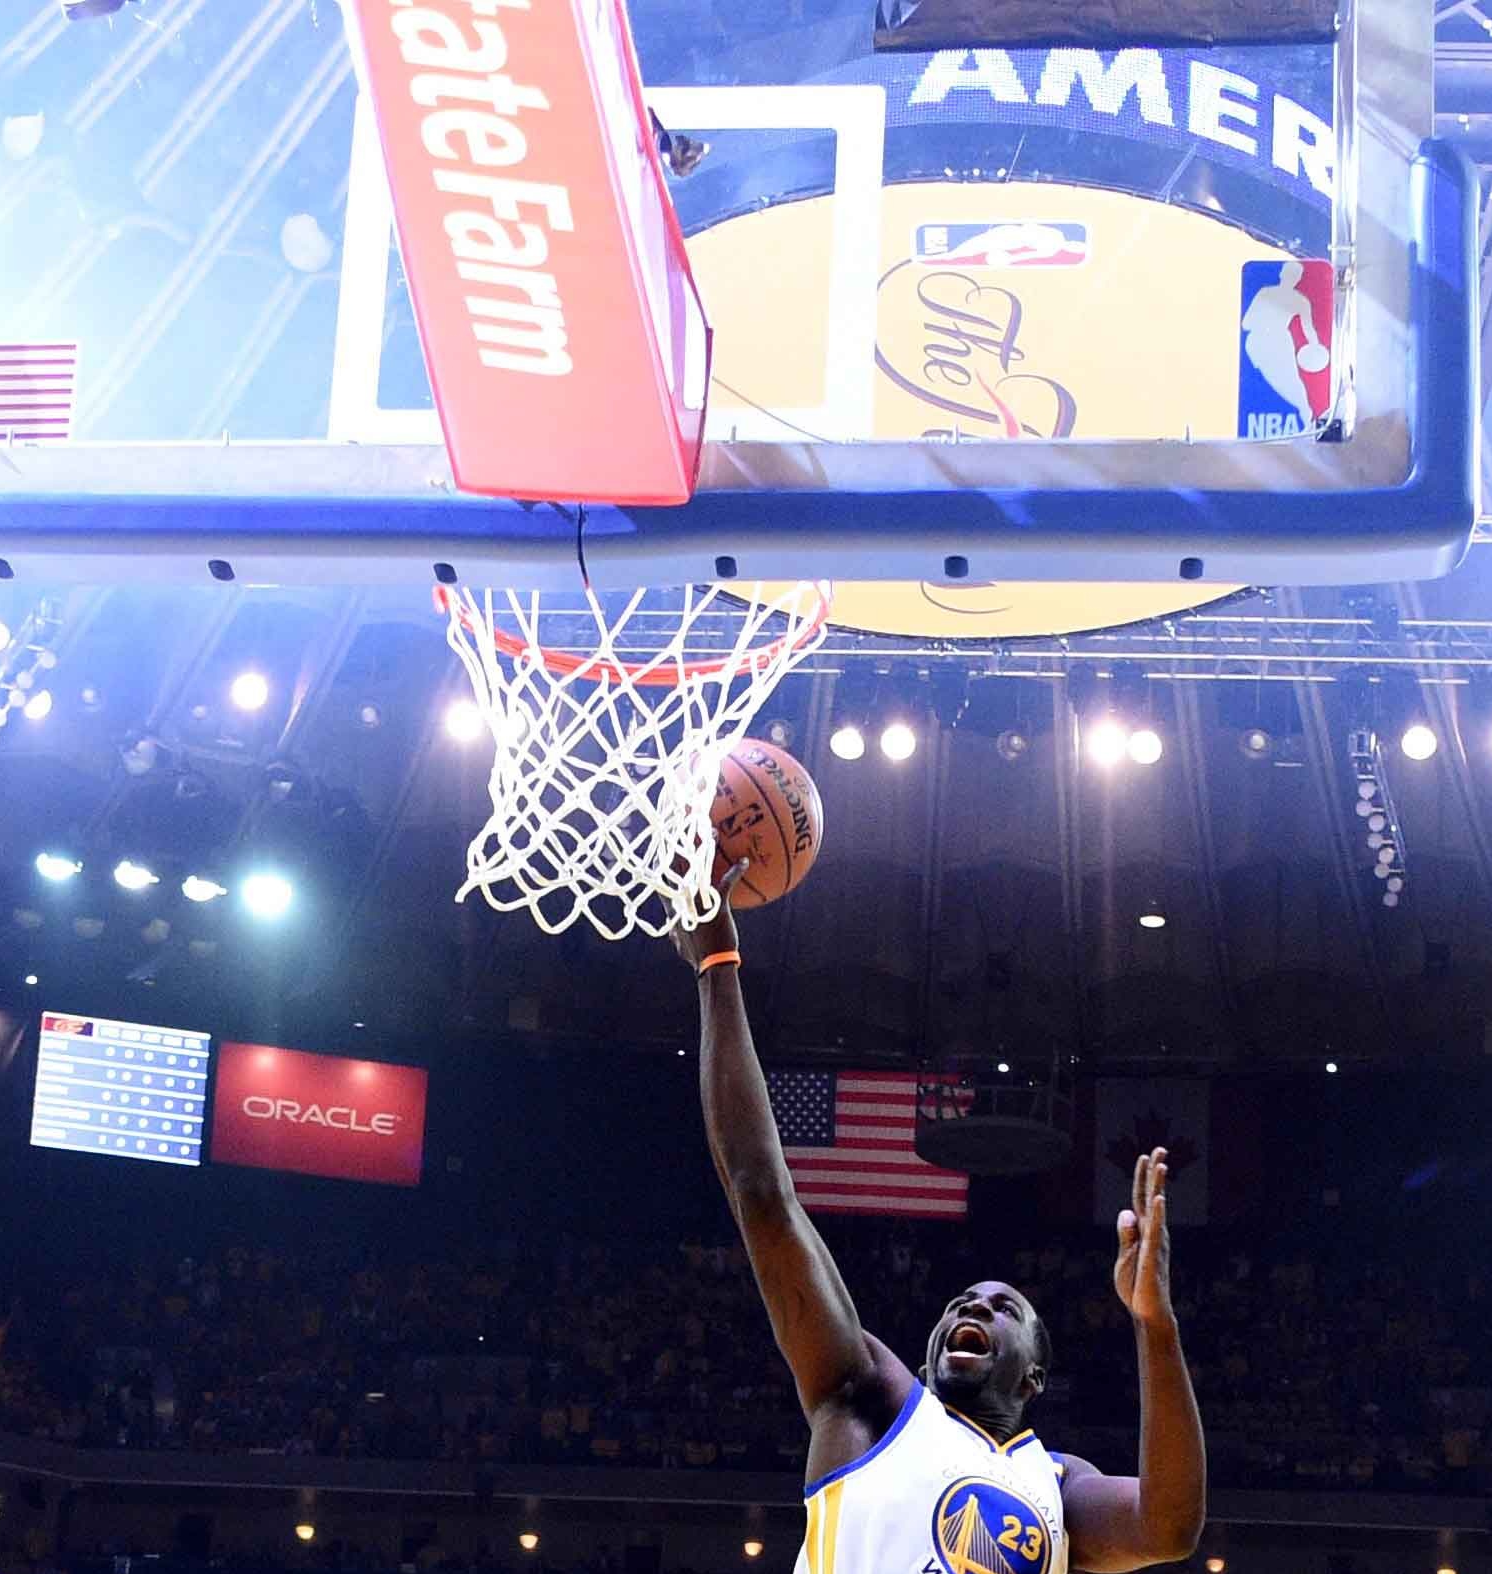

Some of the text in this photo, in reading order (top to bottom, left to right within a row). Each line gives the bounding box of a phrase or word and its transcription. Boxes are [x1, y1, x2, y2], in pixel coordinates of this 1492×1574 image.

[907, 48, 1334, 198] AMER
[1247, 413, 1301, 440] NBA
[242, 1094, 398, 1137] ORACLE
[996, 1514, 1043, 1562] 23
